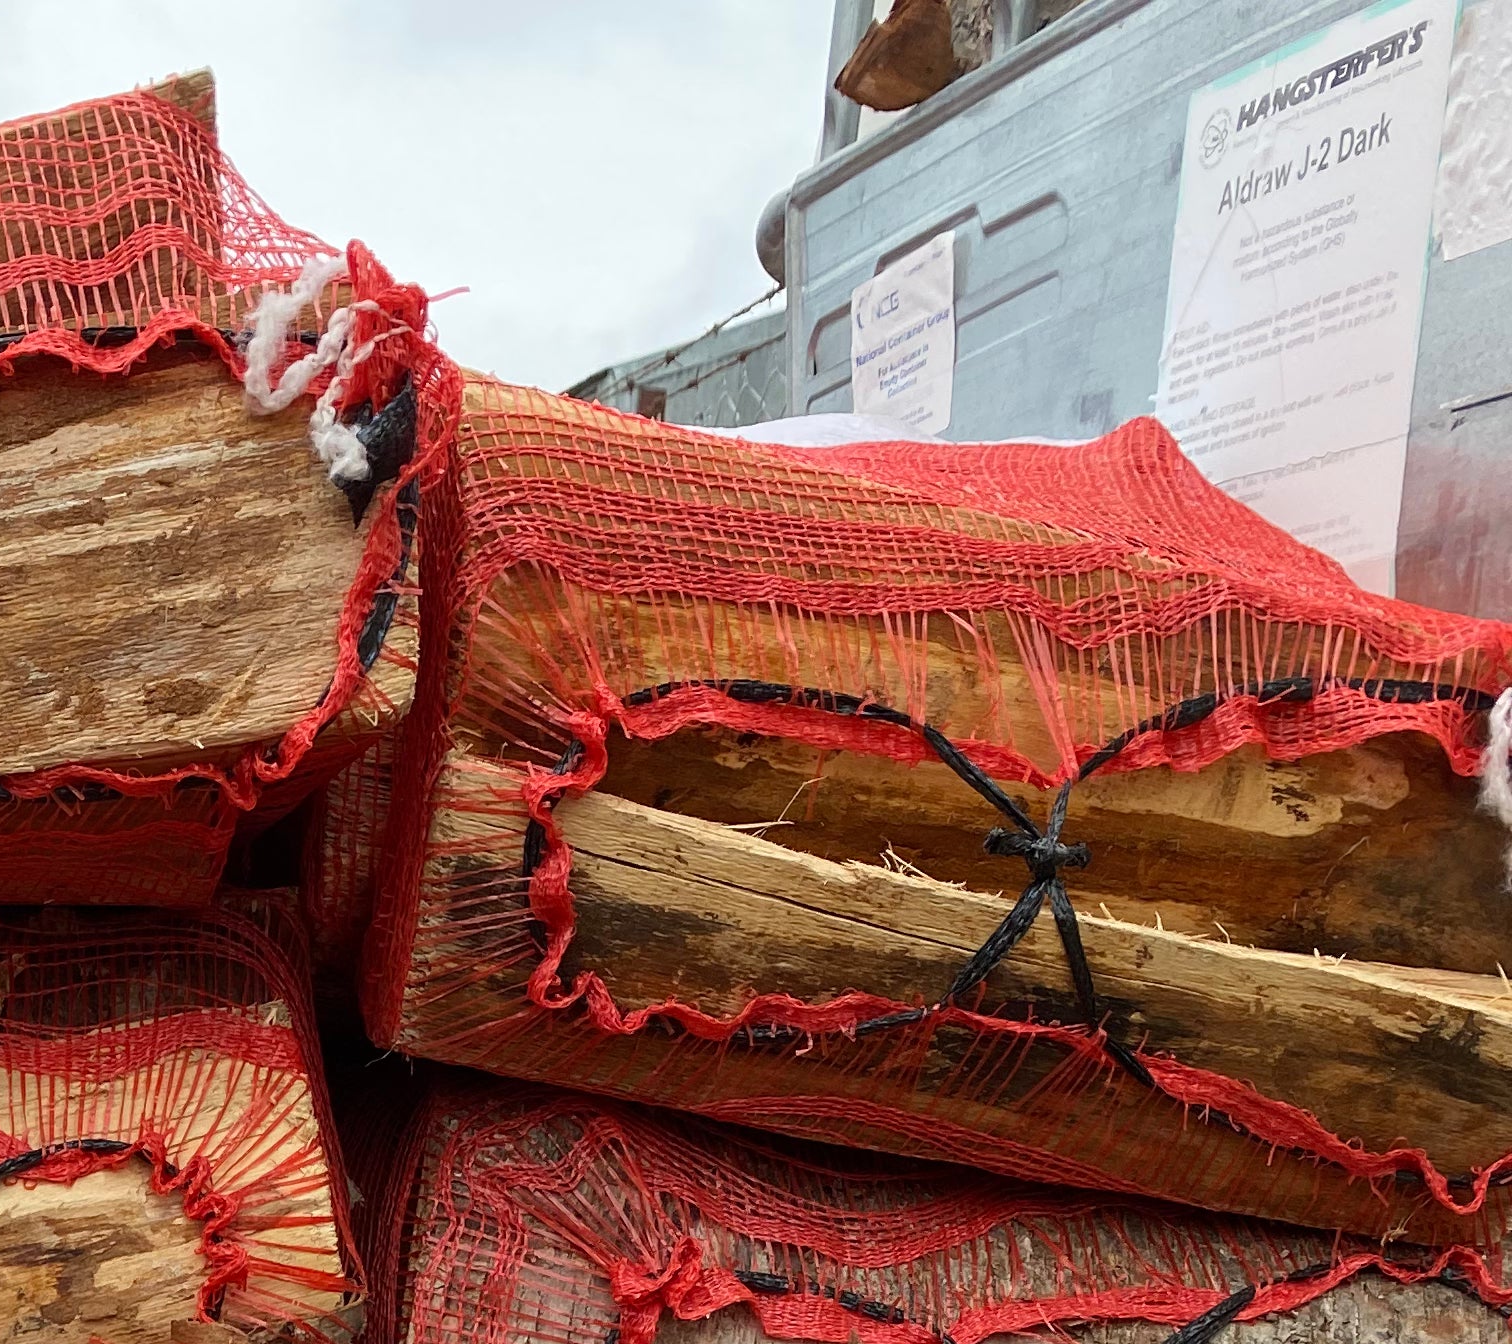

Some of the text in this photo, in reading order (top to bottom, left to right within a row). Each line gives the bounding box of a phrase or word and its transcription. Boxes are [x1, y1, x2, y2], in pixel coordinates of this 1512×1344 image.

[1237, 20, 1428, 132] HANGSTERFER'S
[1218, 111, 1393, 215] Aldraw J-2 Dark
[856, 338, 886, 368] National
